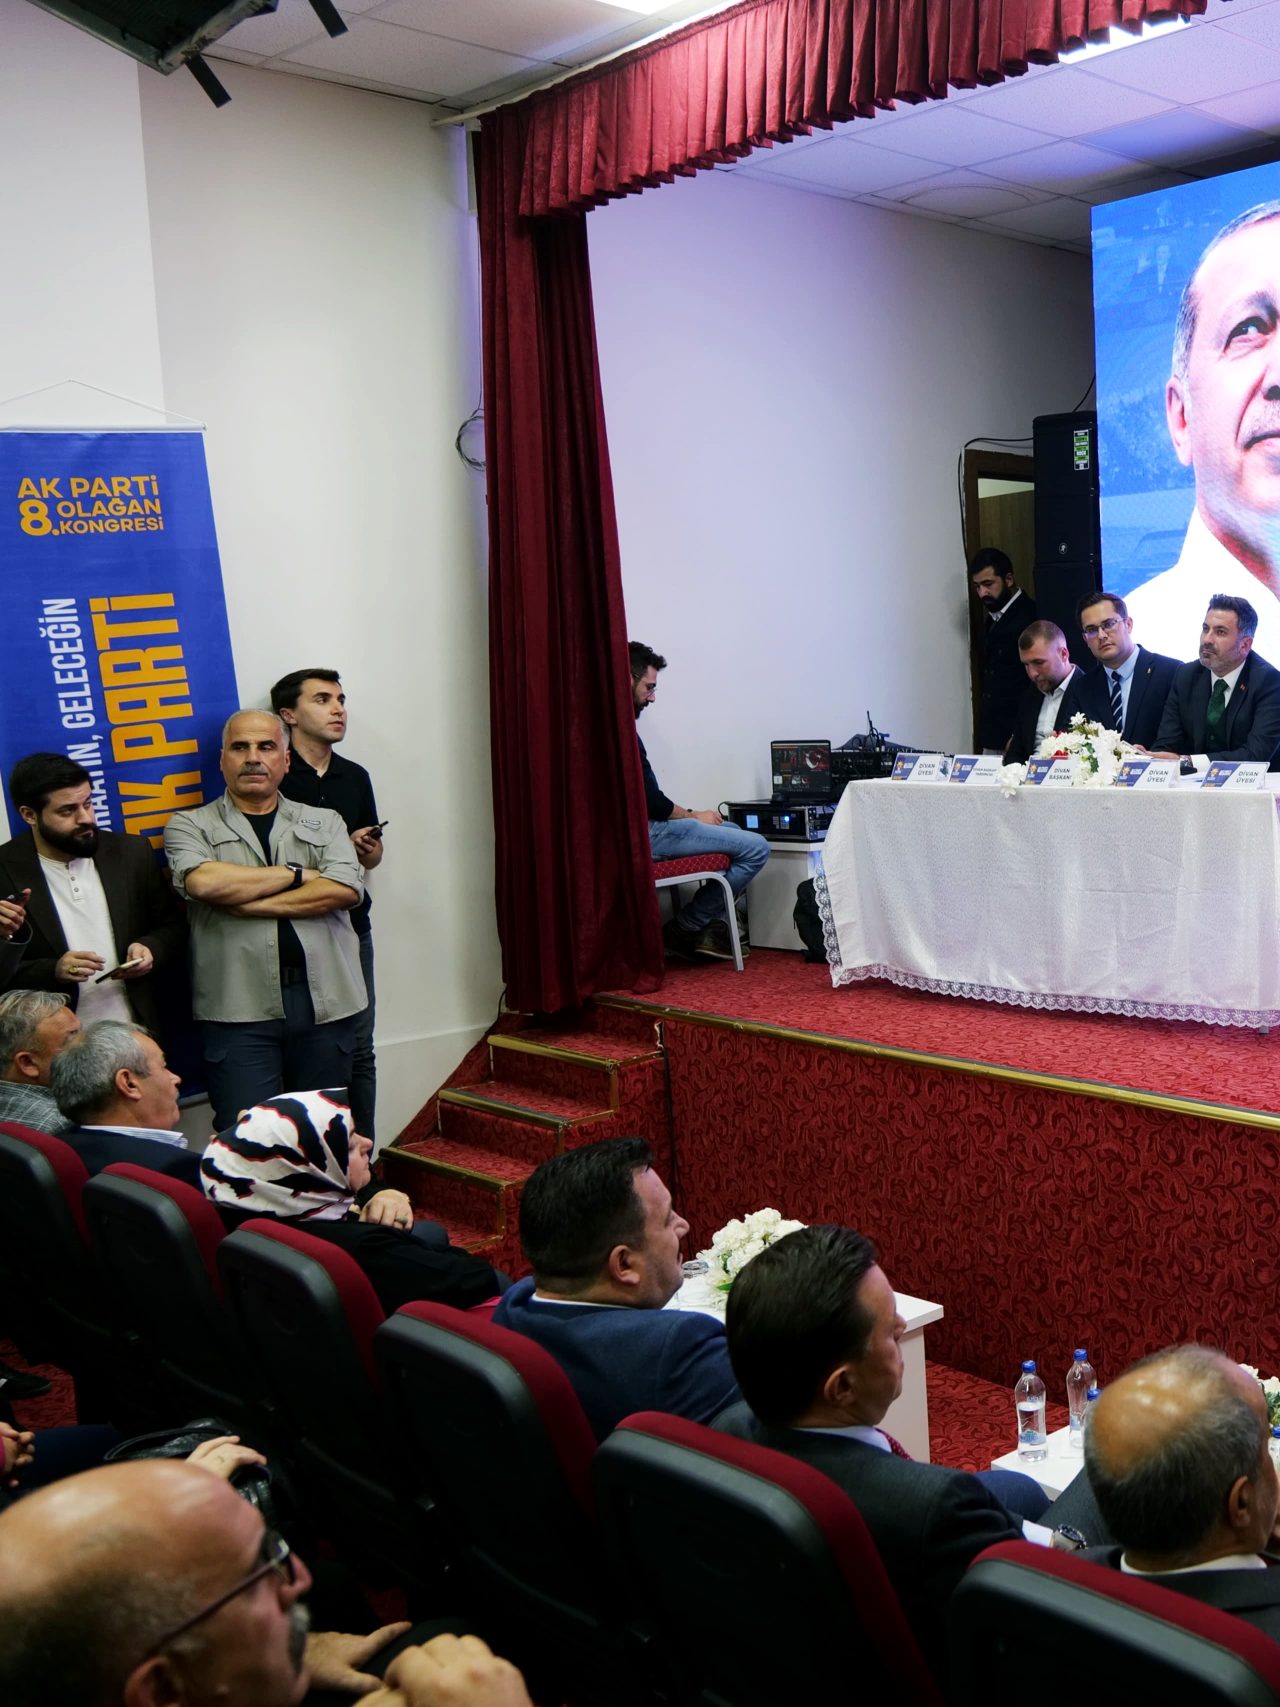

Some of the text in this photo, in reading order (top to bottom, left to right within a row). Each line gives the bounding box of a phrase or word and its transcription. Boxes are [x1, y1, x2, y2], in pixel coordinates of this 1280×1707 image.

[17, 477, 64, 499] AK
[19, 497, 162, 537] 8. OLAĞAN
[39, 597, 96, 729] GELECEĞİN
[1238, 769, 1259, 777] DİVAN
